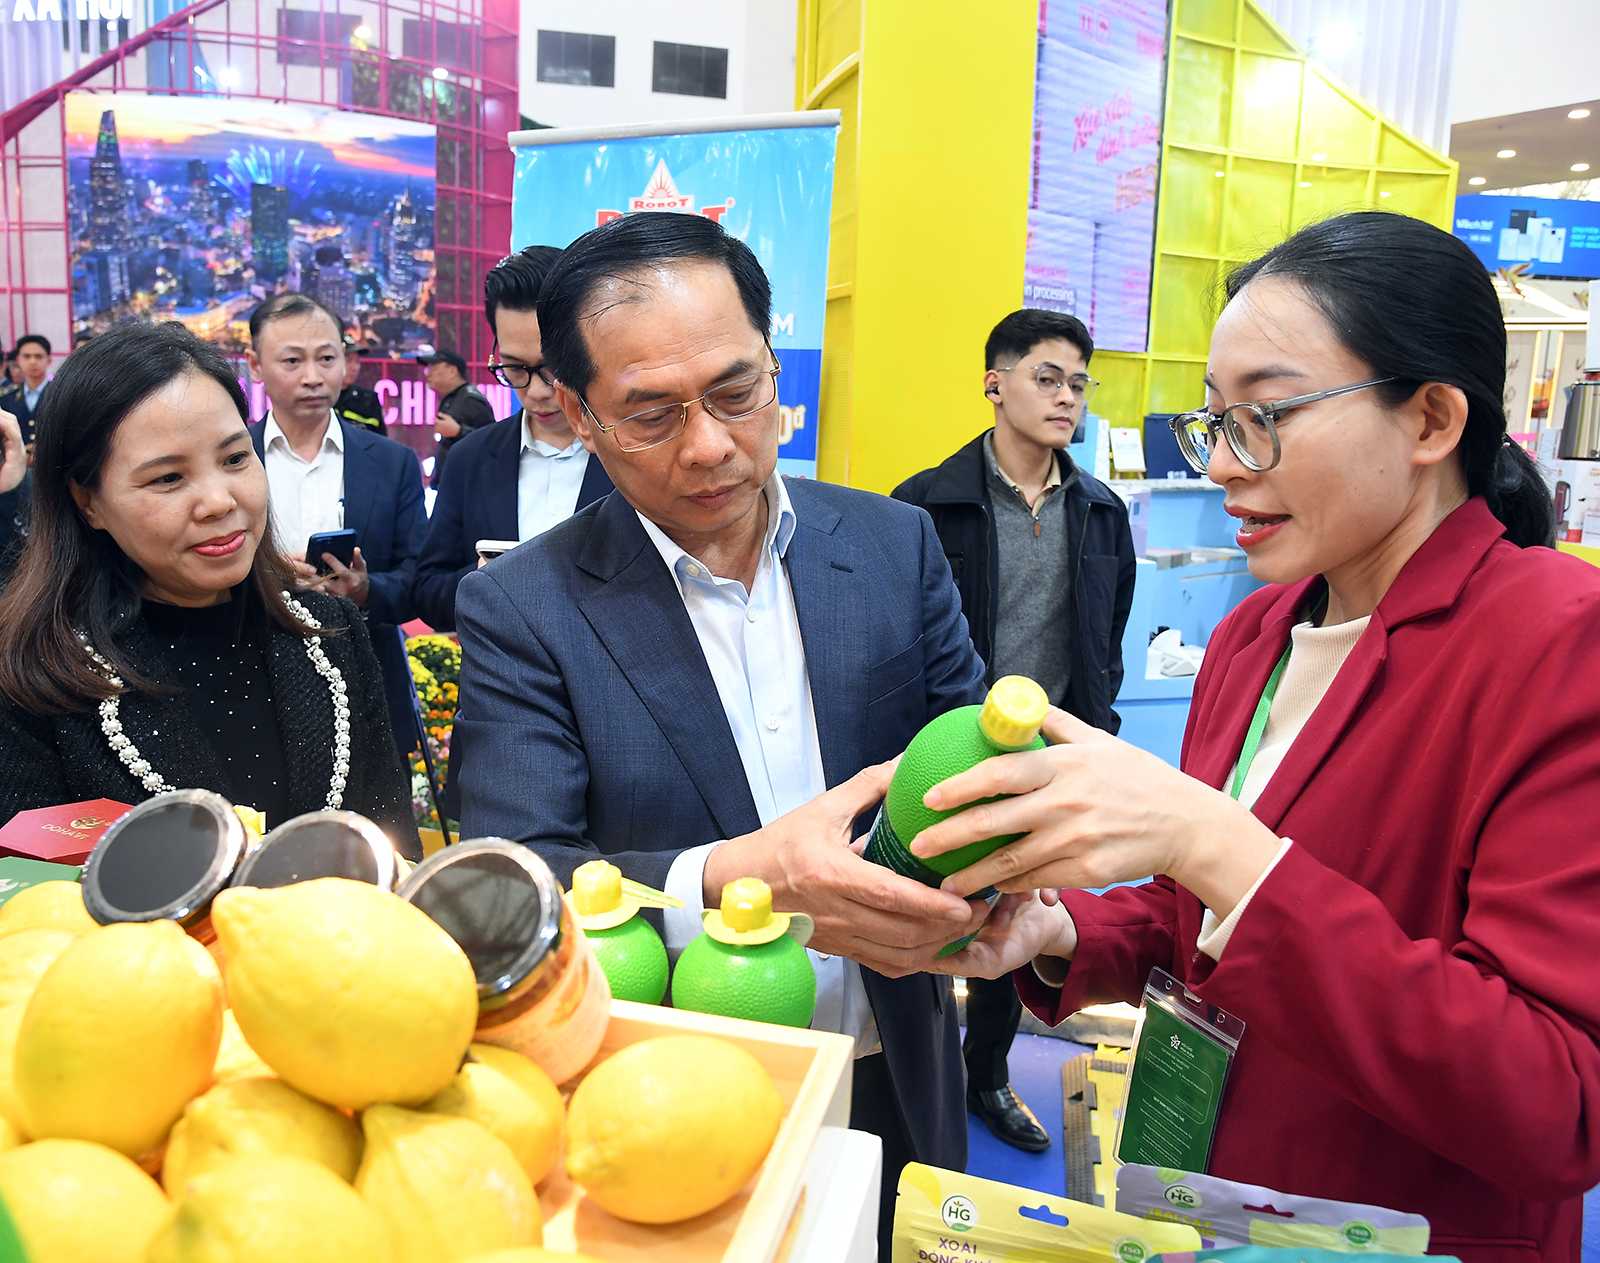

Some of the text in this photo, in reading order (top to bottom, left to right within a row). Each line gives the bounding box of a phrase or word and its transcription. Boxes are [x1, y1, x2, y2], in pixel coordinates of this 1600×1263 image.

[634, 198, 689, 210] ROBOT
[1171, 1192, 1194, 1203] HG
[948, 1205, 971, 1221] HG
